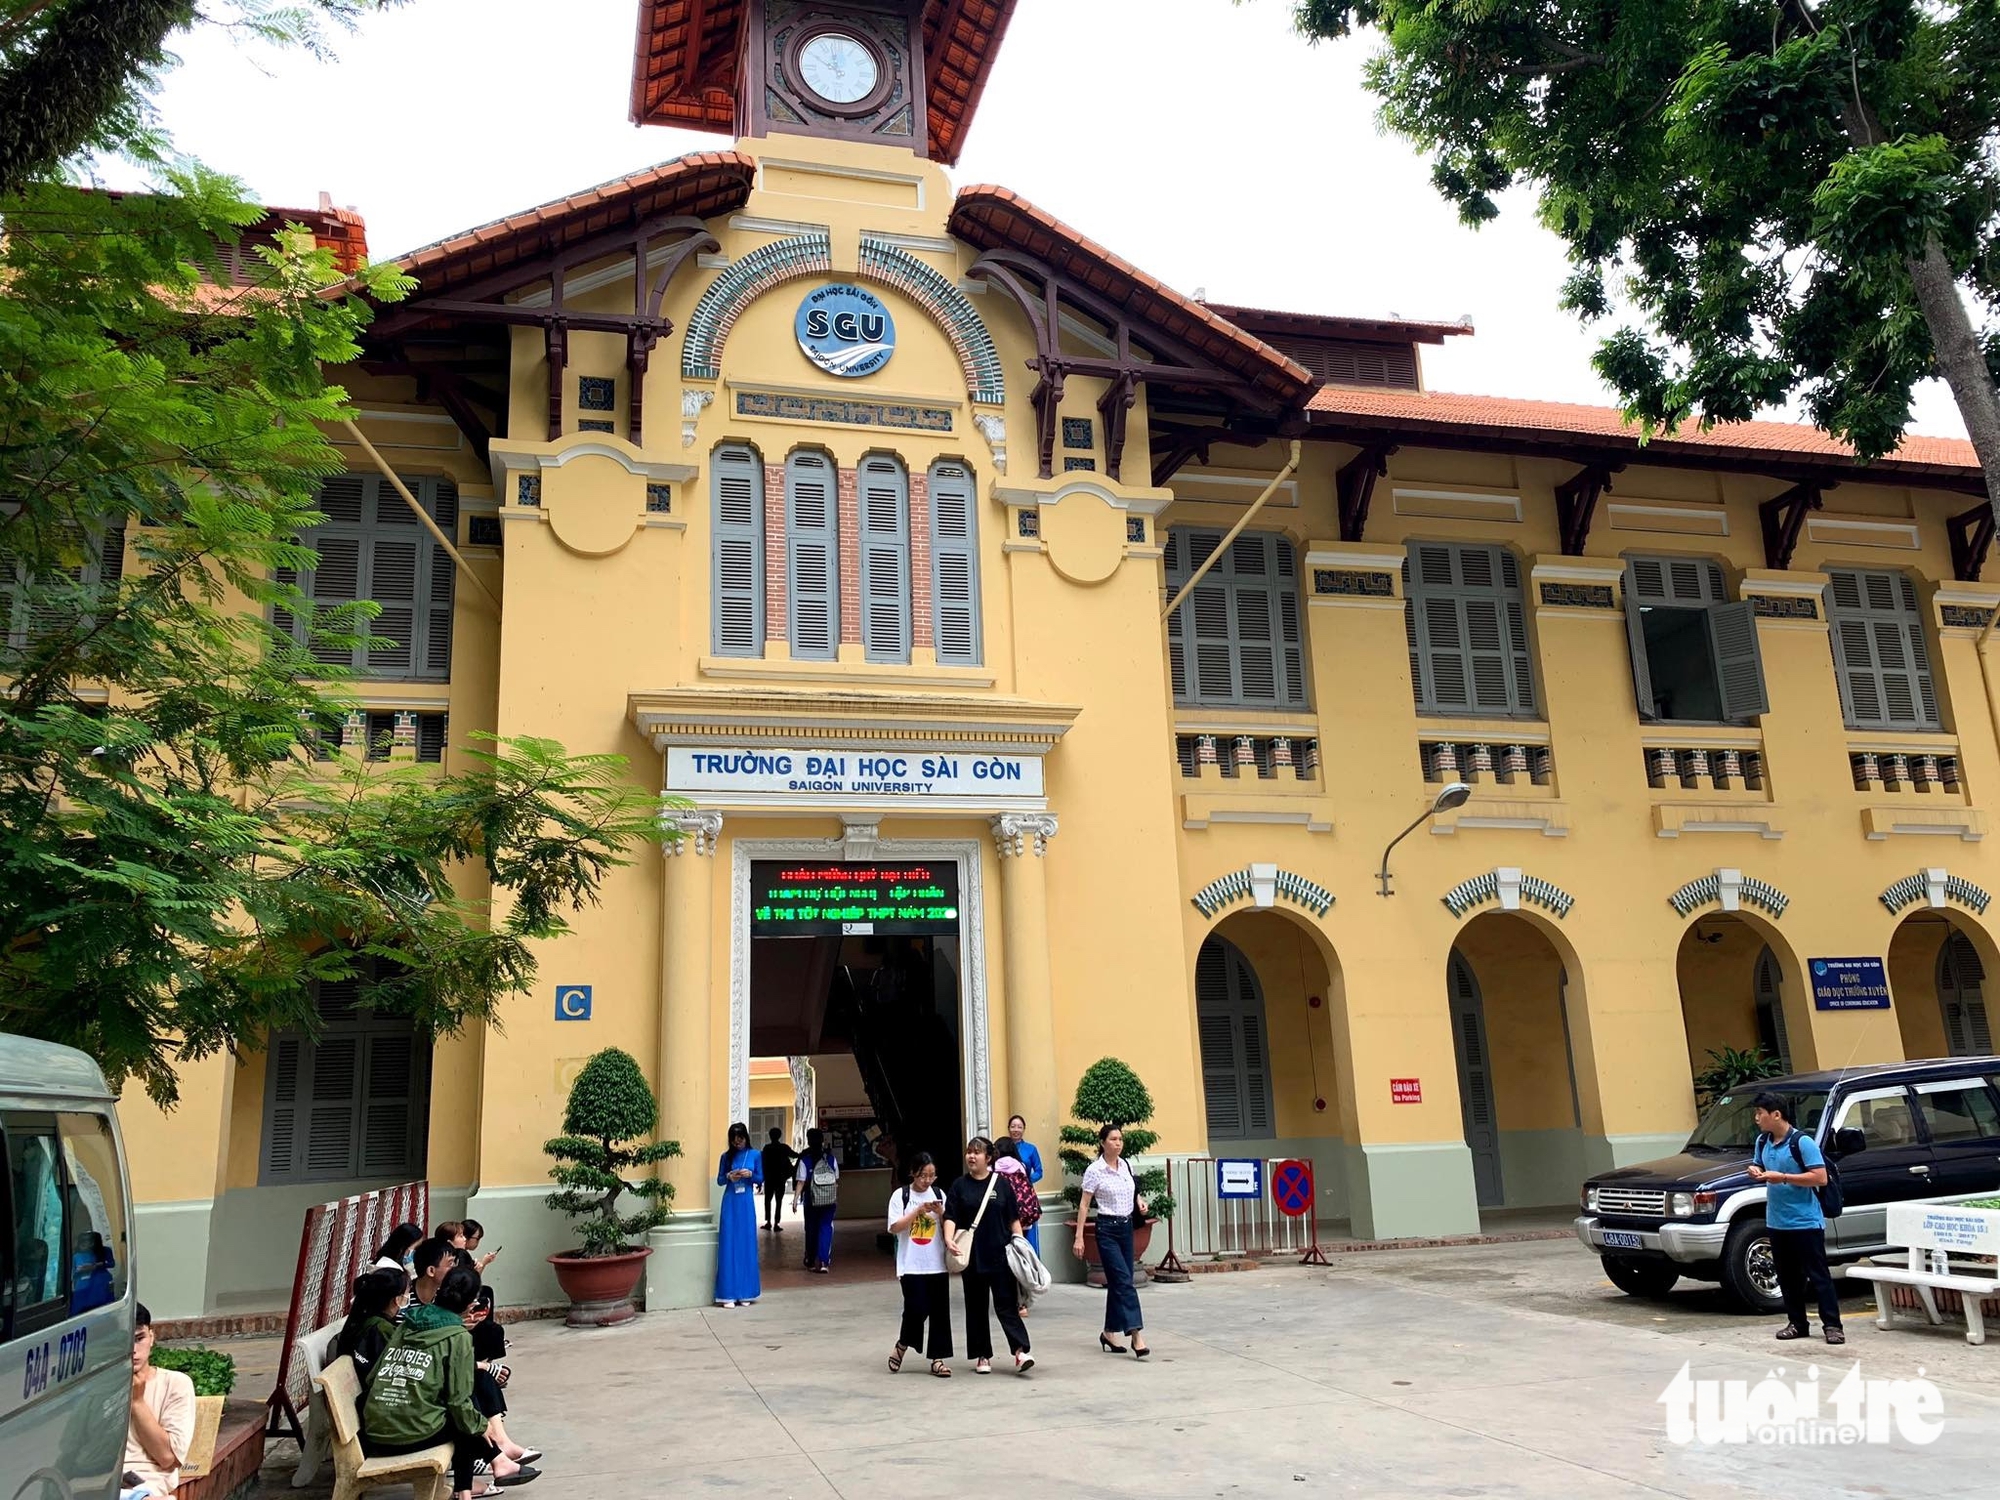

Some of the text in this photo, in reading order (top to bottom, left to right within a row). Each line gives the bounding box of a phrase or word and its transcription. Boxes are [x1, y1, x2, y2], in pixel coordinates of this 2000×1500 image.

[825, 287, 844, 296] HỌC
[845, 287, 859, 297] SÀI
[806, 308, 885, 342] SGU
[808, 344, 884, 373] SAIGON UNIVERSITY
[692, 750, 1021, 780] TRƯỜNG ĐẠI HỌC SÀI GÒN
[788, 780, 933, 793] SAIGON UNIVERSITY
[774, 908, 795, 920] THI
[867, 907, 896, 919] THPT
[1840, 972, 1860, 984] PHÒNG
[1817, 986, 1831, 997] GIÁO
[1832, 987, 1844, 999] DỤC
[562, 990, 586, 1017] C
[1935, 1222, 1945, 1230] CAO
[1947, 1222, 1958, 1231] HỌC
[384, 1347, 433, 1368] ZOMBIES
